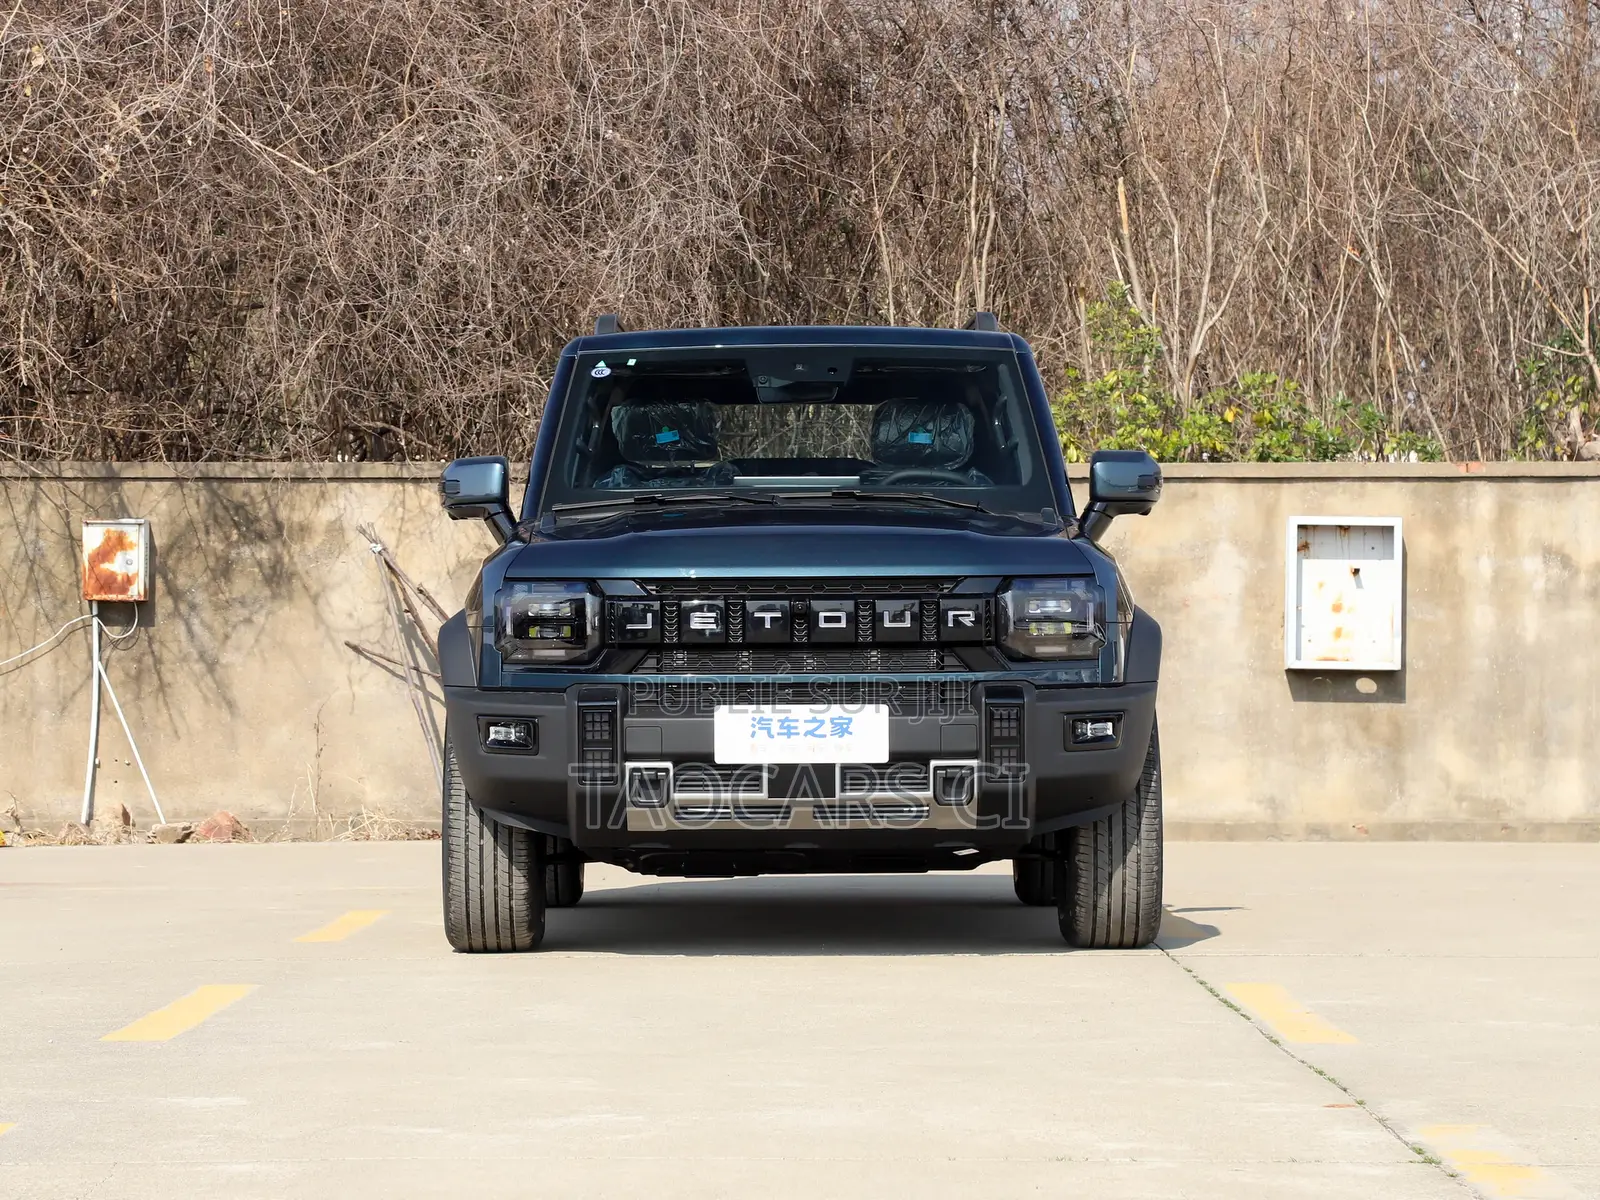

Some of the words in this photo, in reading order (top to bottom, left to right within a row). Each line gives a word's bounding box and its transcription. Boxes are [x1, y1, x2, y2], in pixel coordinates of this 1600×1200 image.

[625, 610, 976, 630] JETOUR
[750, 716, 853, 739] 汽车之家
